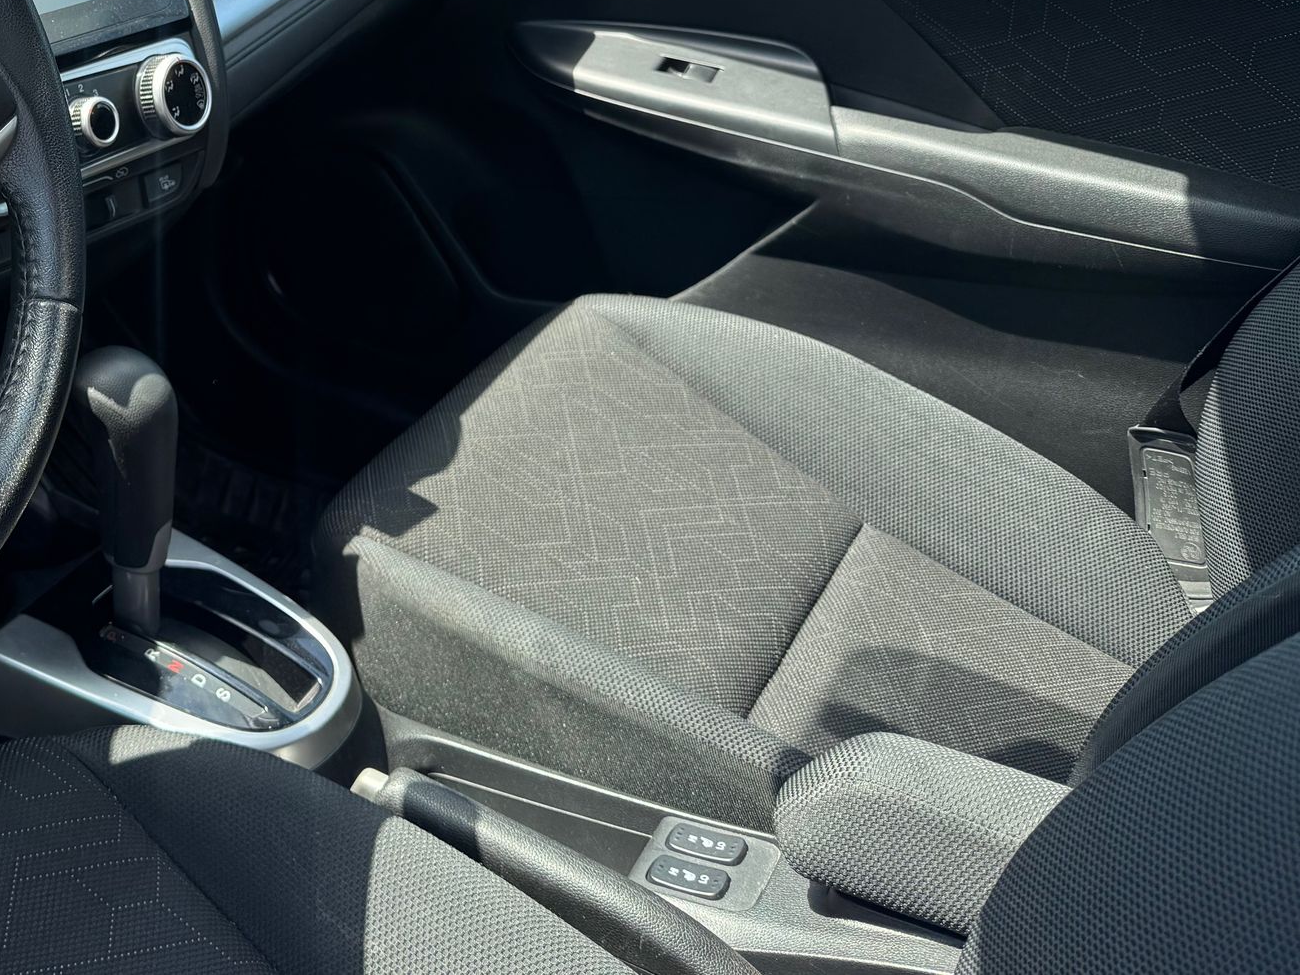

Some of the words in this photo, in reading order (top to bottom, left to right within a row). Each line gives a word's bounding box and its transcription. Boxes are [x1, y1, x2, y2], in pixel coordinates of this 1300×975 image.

[77, 83, 84, 93] 2
[144, 648, 160, 662] R
[167, 659, 185, 673] N
[191, 673, 207, 689] D
[215, 687, 231, 702] S
